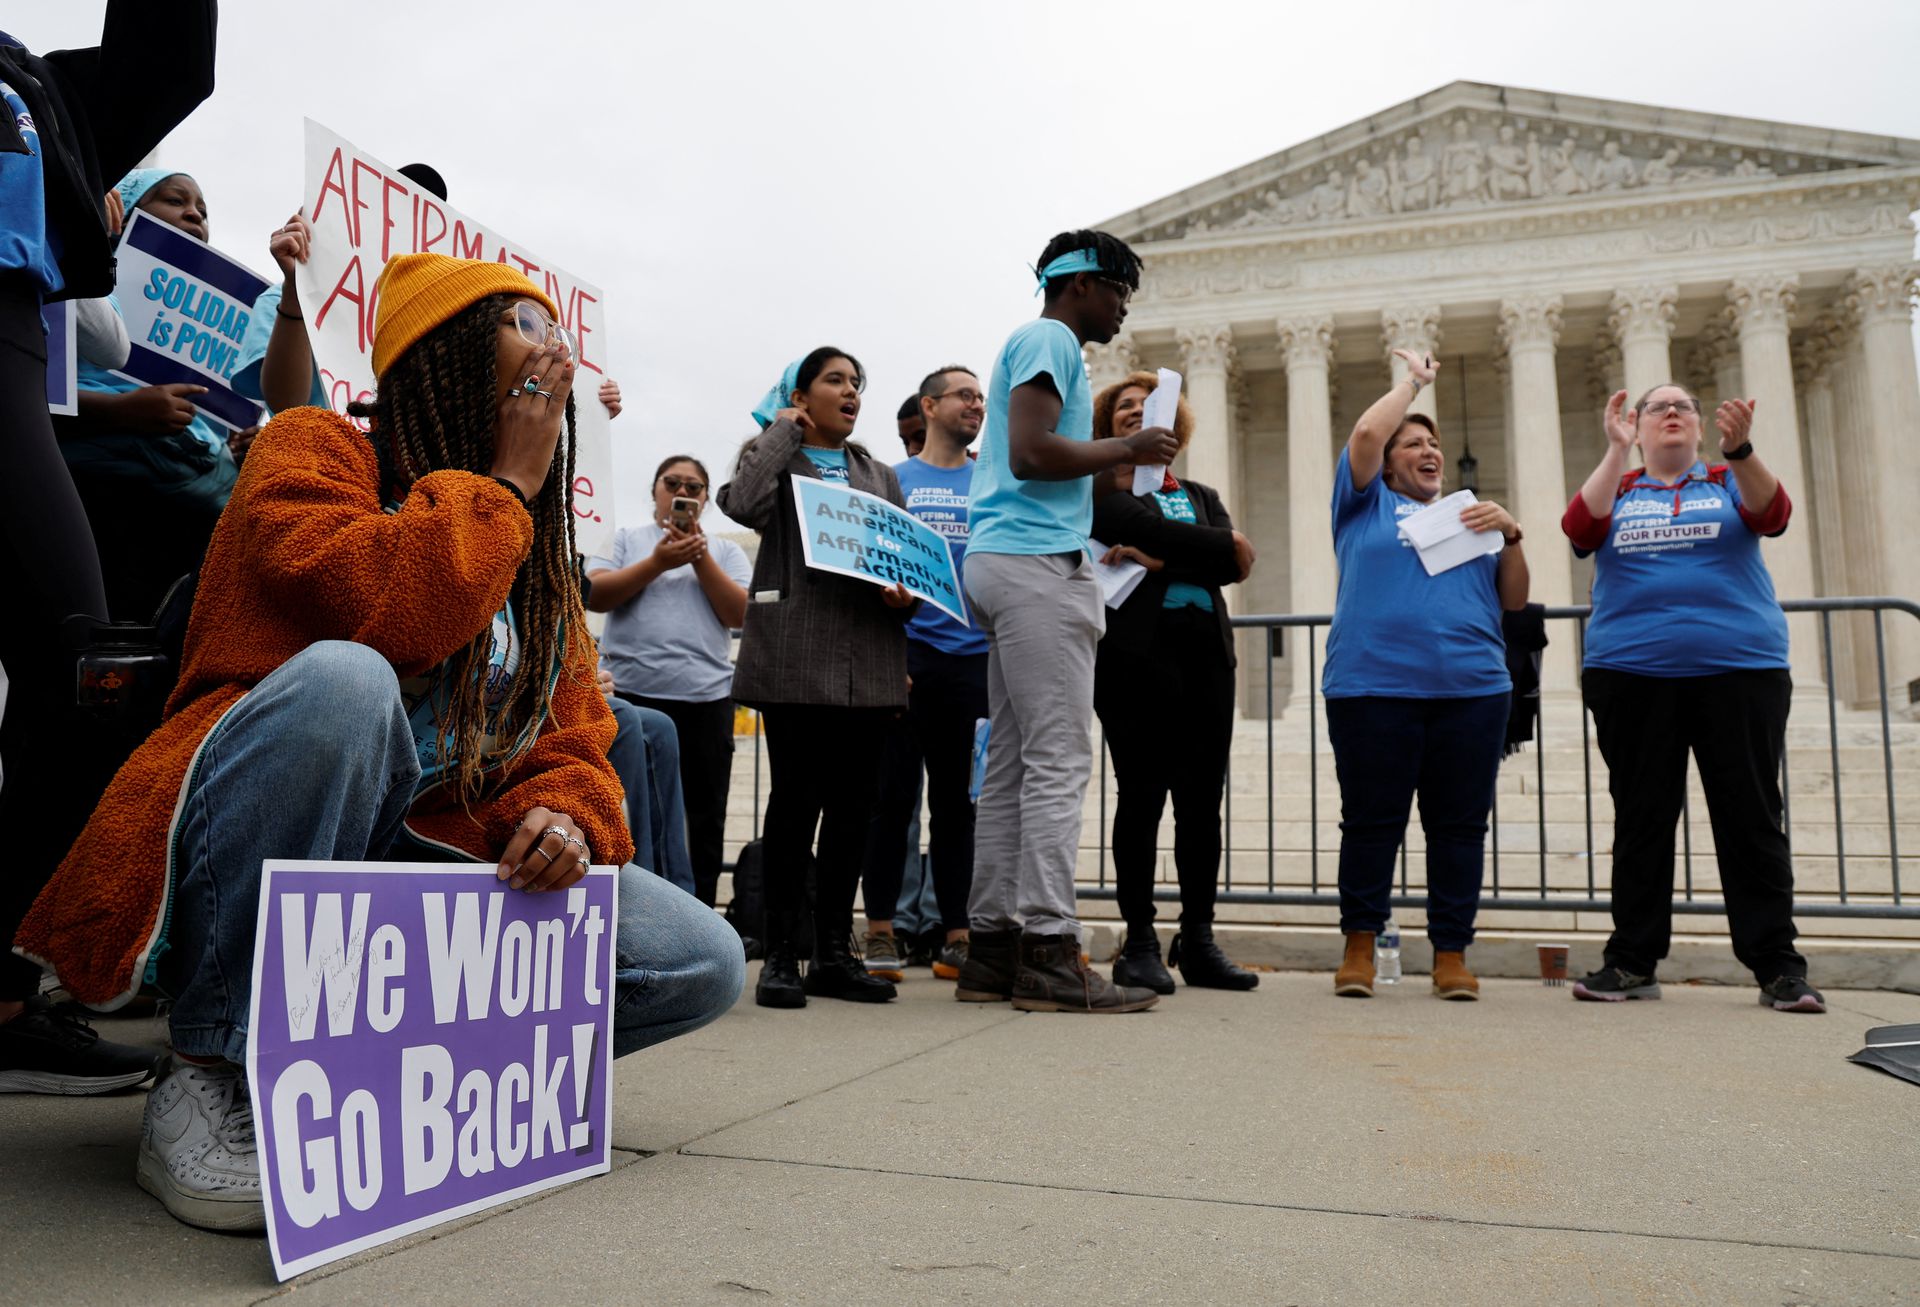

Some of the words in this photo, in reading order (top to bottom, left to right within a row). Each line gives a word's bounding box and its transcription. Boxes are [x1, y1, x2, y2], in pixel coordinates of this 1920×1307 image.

[312, 147, 603, 375] AFFIRMVE
[143, 267, 250, 345] SOLIDAR
[147, 310, 174, 348] is
[171, 322, 241, 380] POWE
[911, 487, 954, 496] AFFIRM
[912, 496, 967, 505] OPPORTU
[815, 502, 944, 565] Americans
[847, 495, 915, 533] Asian
[914, 512, 956, 522] AFFIRM
[941, 523, 970, 535] FUTU
[1619, 517, 1671, 530] AFFIRM
[1620, 530, 1649, 542] OUR
[1653, 525, 1712, 539] FUTURE
[875, 534, 902, 553] for
[816, 531, 955, 597] Affirmative
[853, 556, 936, 598] Action
[280, 892, 406, 1042] We
[422, 887, 605, 1025] Won't
[271, 1059, 384, 1229] Go
[400, 1022, 598, 1196] Back!
